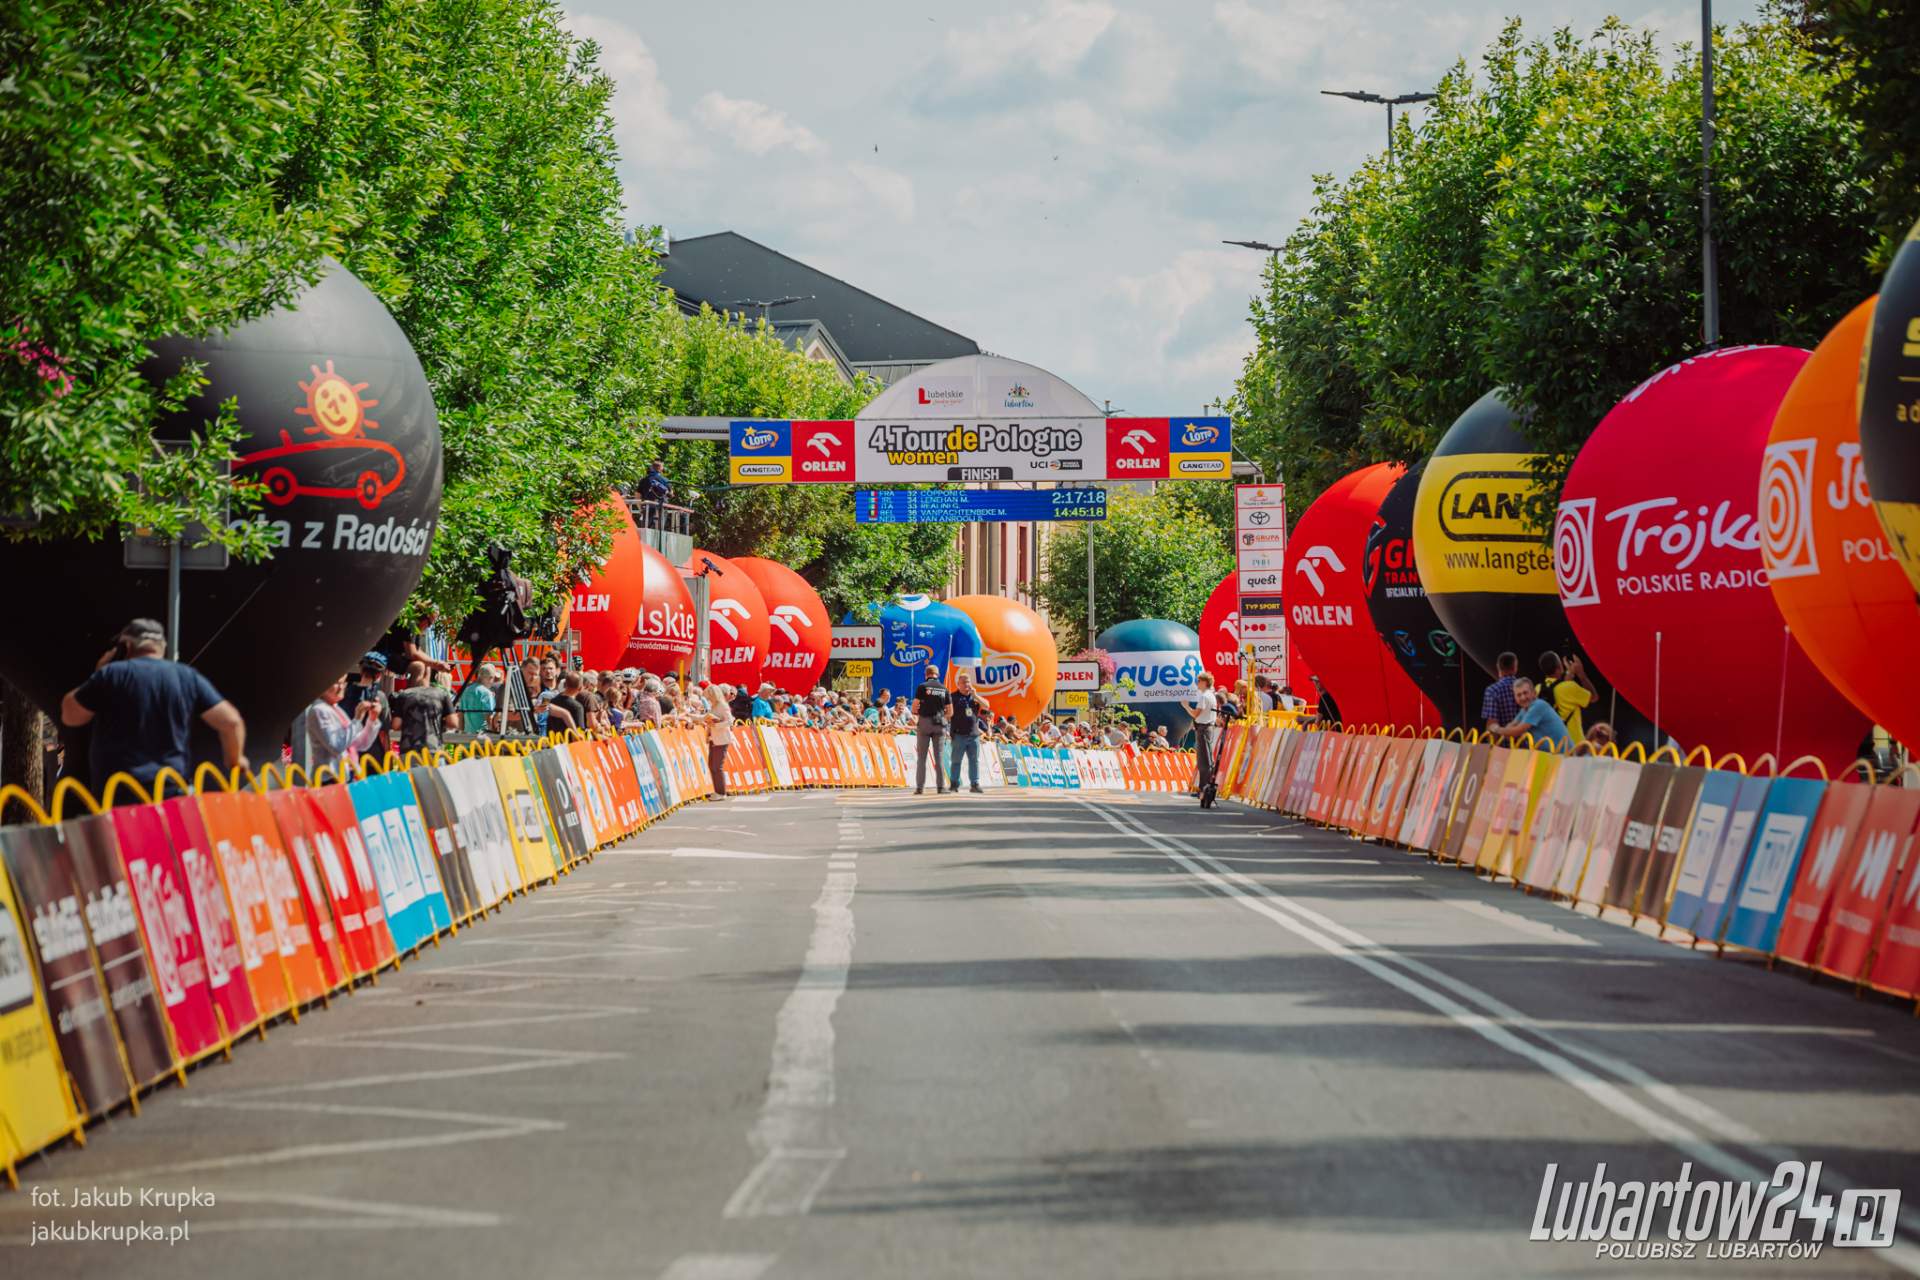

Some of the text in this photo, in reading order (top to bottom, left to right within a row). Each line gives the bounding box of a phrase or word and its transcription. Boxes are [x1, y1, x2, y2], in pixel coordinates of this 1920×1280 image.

[887, 450, 959, 465] women
[1115, 458, 1161, 469] ORLEN
[801, 460, 846, 472] ORLEN
[1030, 461, 1048, 469] UCI
[961, 469, 1000, 481] FINISH
[1052, 491, 1105, 504] 2:17:18
[1054, 507, 1105, 519] 14:45:18
[301, 521, 325, 549] z
[333, 514, 432, 556] Radości
[1247, 574, 1277, 588] quest
[1617, 572, 1693, 596] POLSKIE
[1292, 605, 1353, 626] ORLEN
[831, 637, 876, 648] ORLEN
[1258, 643, 1281, 652] onet
[898, 649, 926, 663] LOTTO
[849, 663, 871, 674] 25m
[975, 662, 1020, 685] LOTTO
[1068, 694, 1088, 703] 50m
